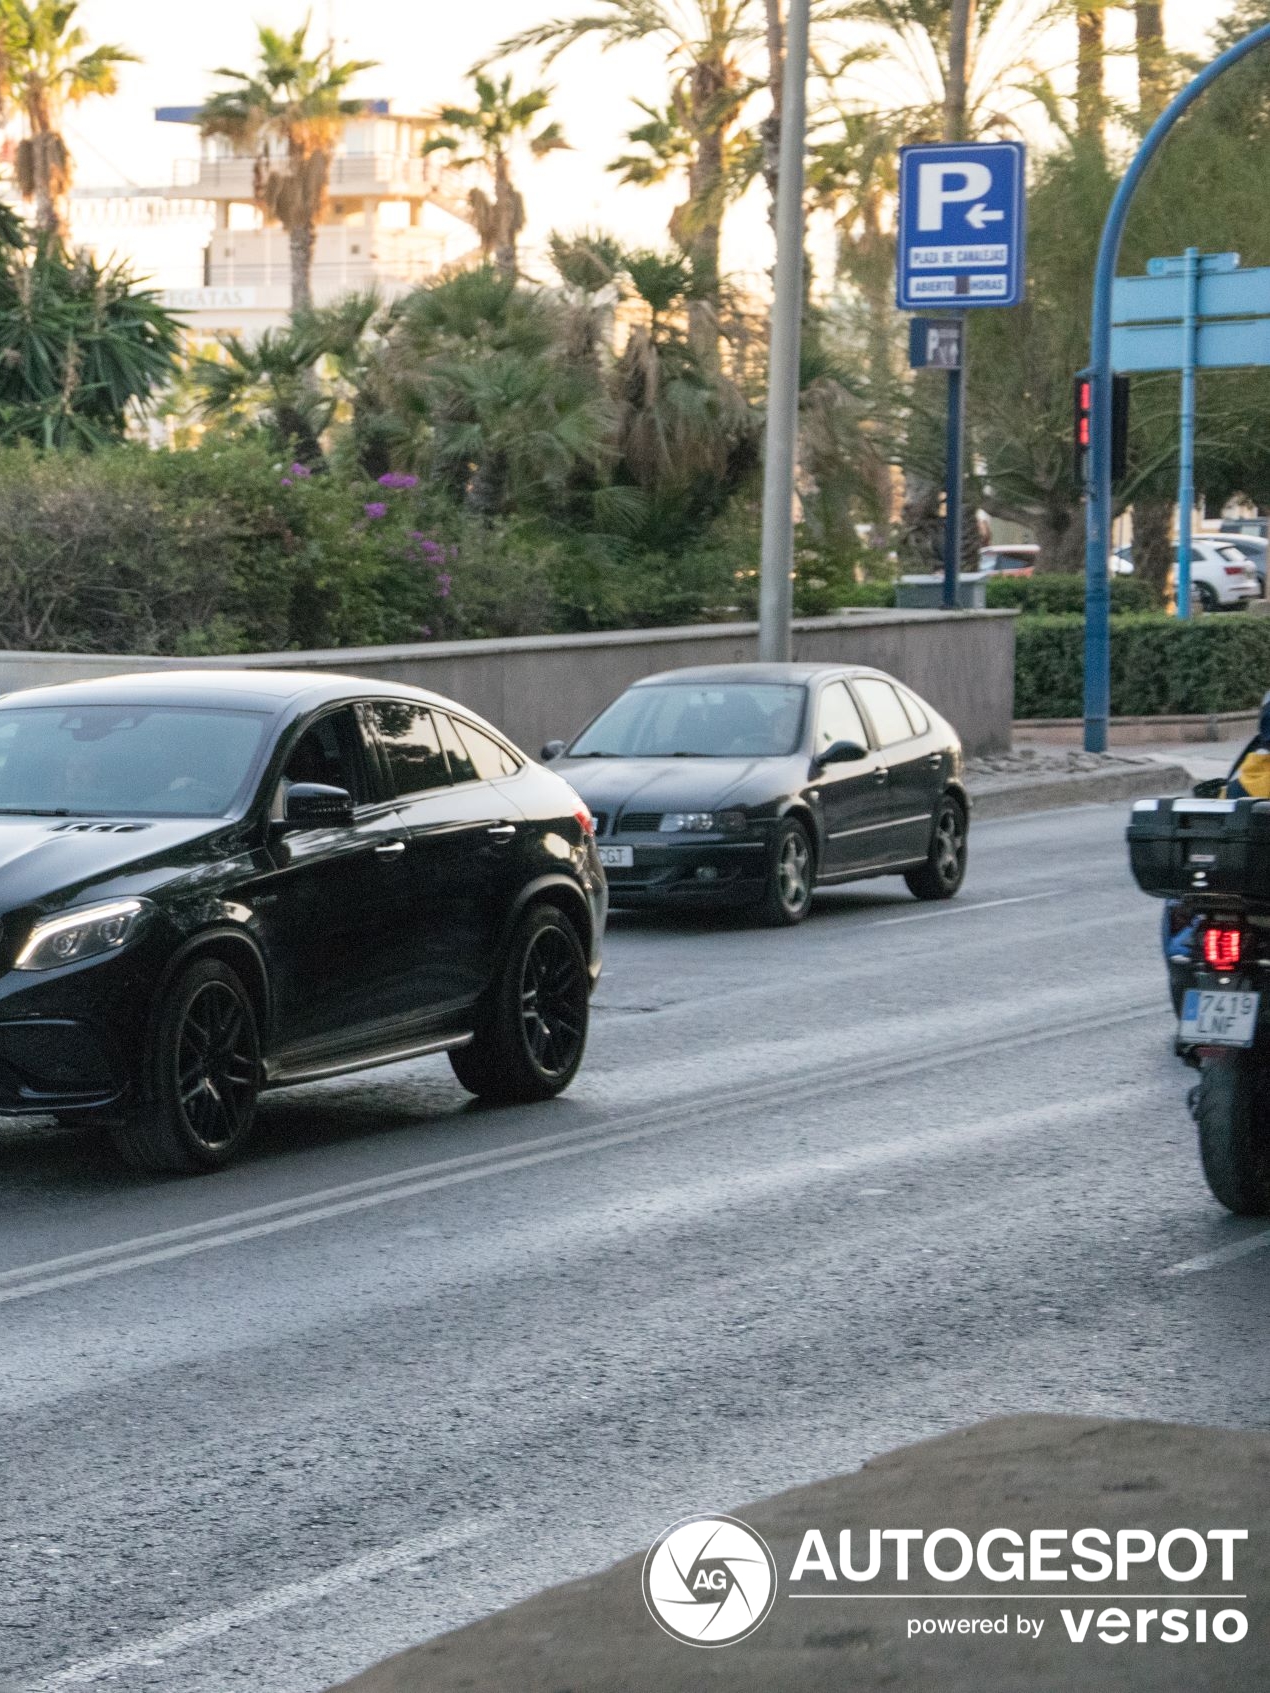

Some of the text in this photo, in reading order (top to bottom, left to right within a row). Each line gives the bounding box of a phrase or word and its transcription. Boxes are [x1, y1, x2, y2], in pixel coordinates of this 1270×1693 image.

[917, 162, 992, 231] P
[913, 249, 1005, 264] PLAZA DE CANALEJAS
[915, 281, 956, 292] ABIERTO
[166, 290, 244, 306] EGATAS
[1201, 994, 1252, 1015] 7419
